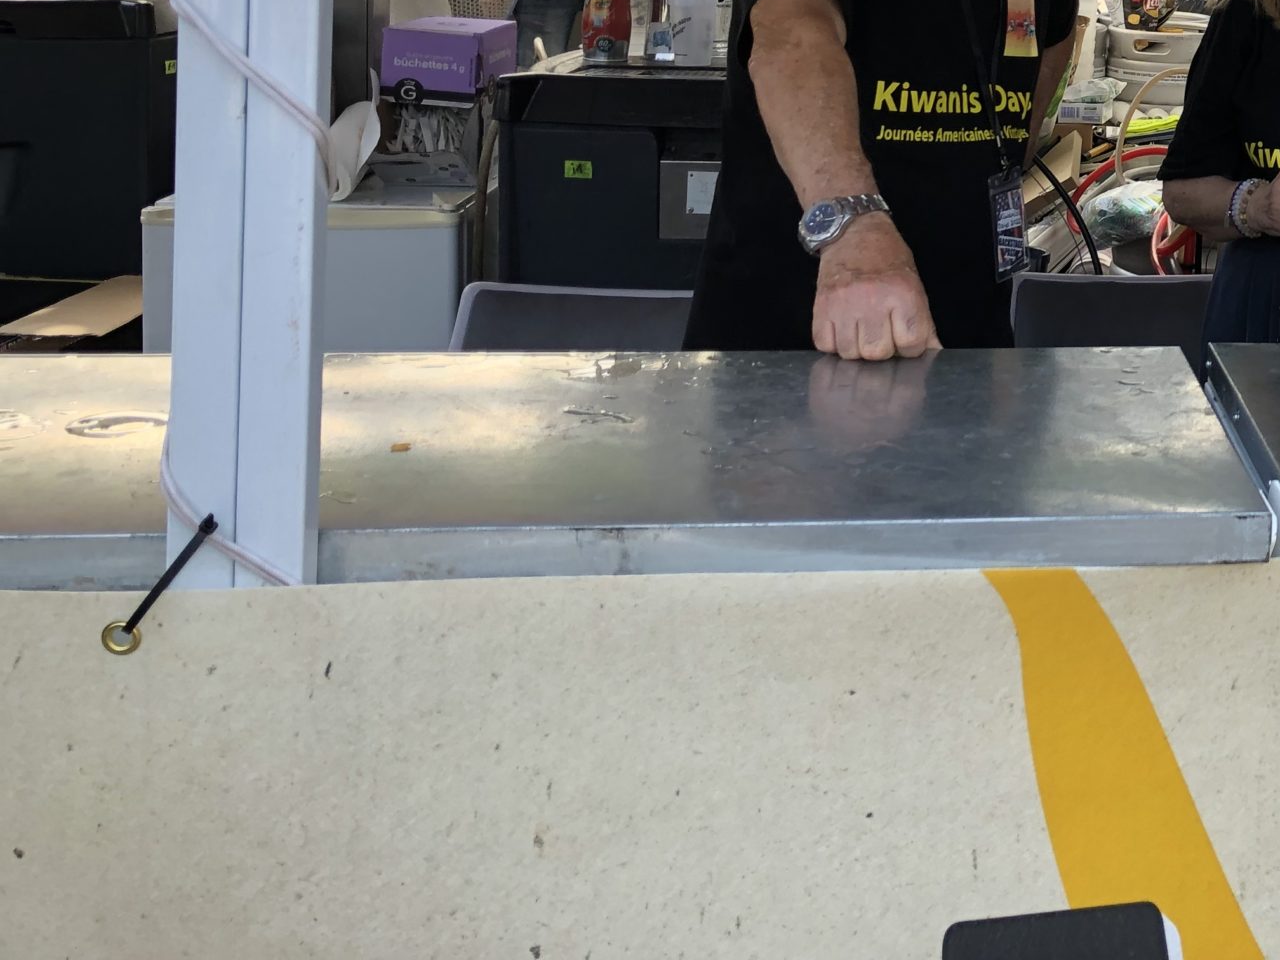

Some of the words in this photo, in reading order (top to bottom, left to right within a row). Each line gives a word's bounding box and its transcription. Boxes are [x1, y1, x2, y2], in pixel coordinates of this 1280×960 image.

[393, 56, 449, 71] bûchettes
[400, 85, 417, 100] G
[873, 79, 982, 114] Kiwanis
[876, 125, 934, 142] Journées
[935, 127, 994, 142] Americaines
